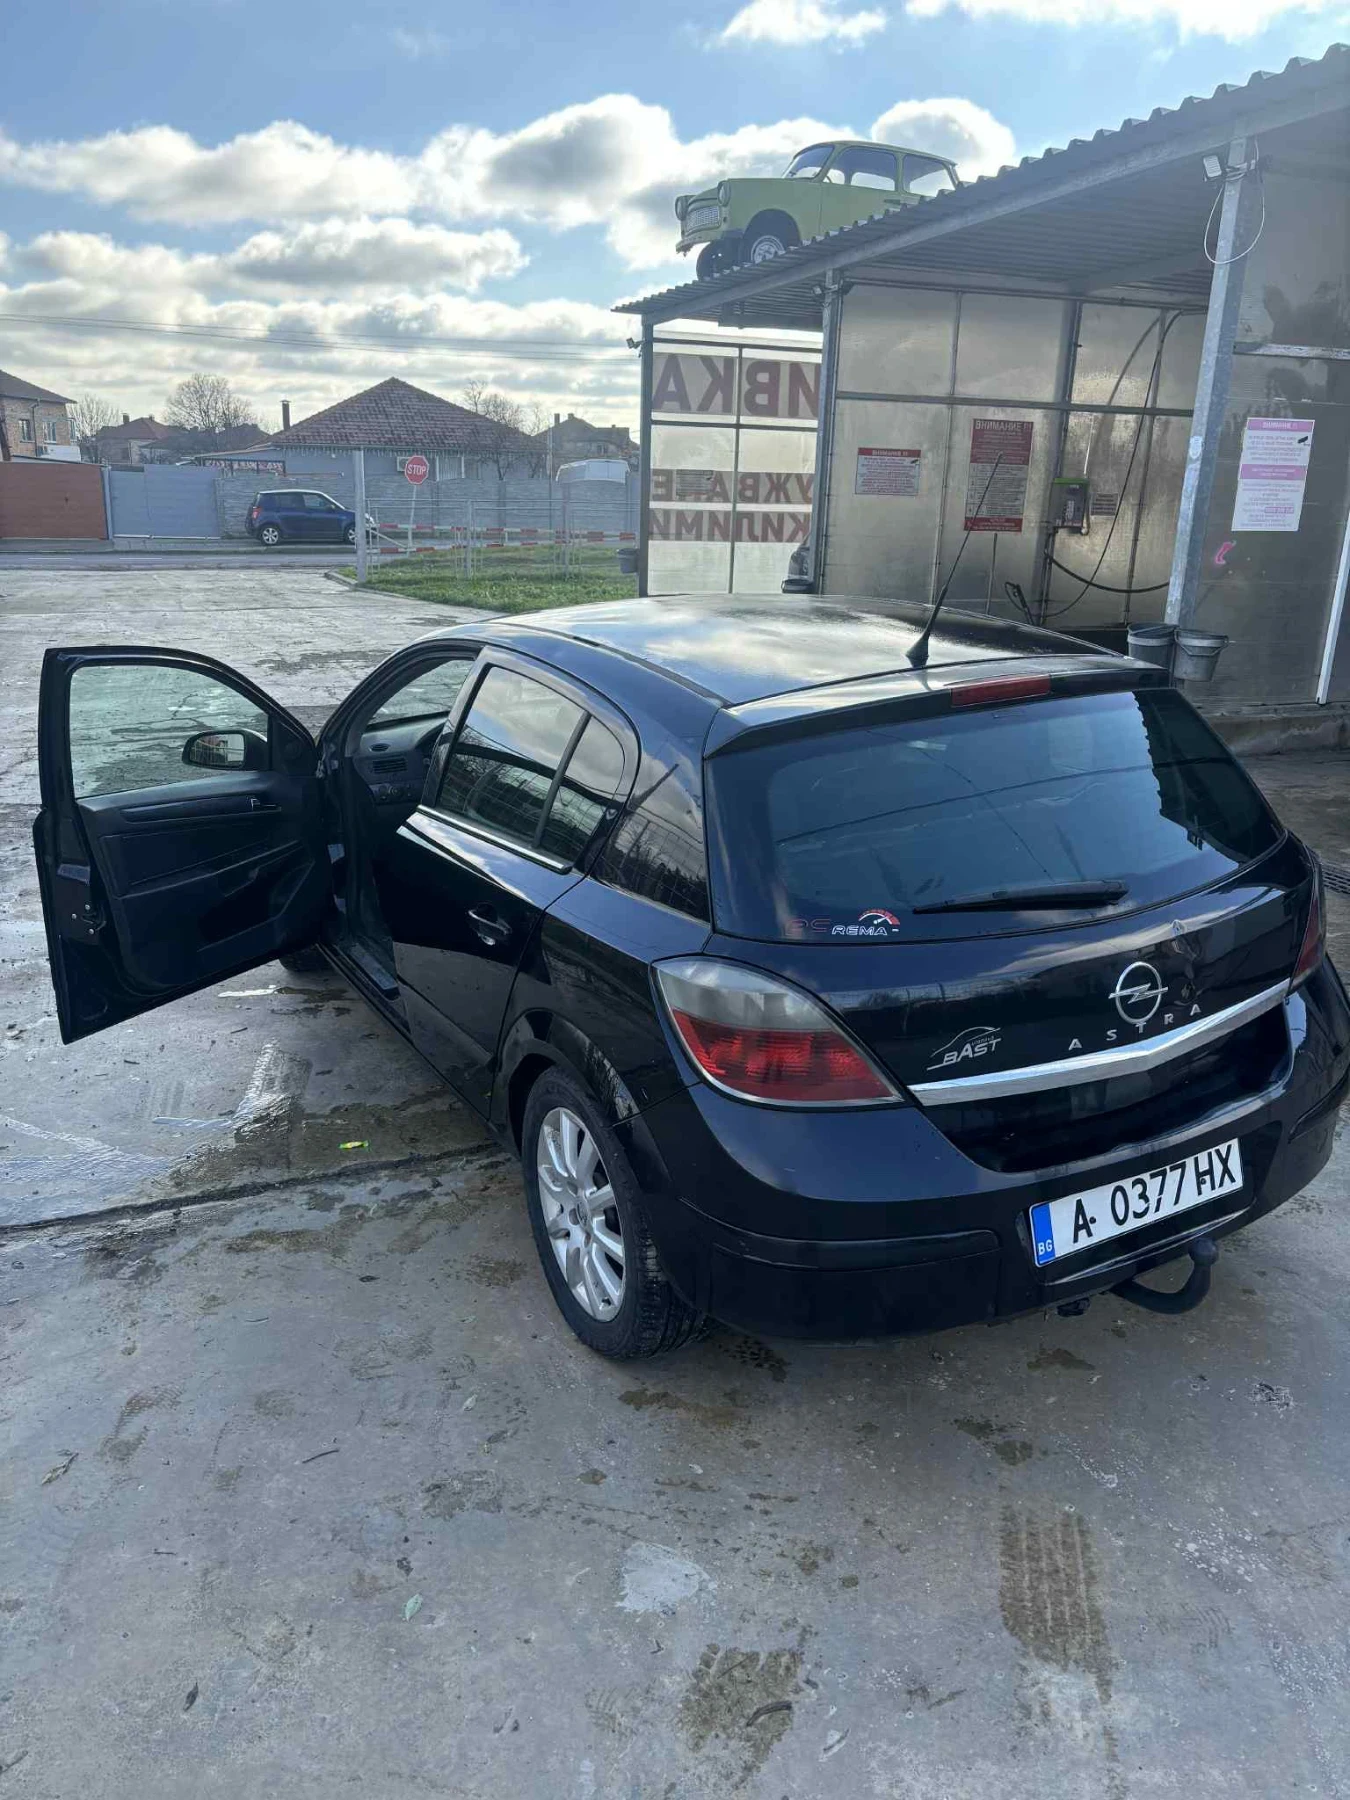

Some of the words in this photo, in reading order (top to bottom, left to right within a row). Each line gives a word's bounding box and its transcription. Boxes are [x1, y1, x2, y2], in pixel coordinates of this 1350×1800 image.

[975, 420, 1022, 431] ВНИМАНИЕ
[407, 464, 426, 475] STOP
[1068, 1003, 1202, 1051] ASTRA
[941, 1038, 1002, 1065] BAST
[1072, 1198, 1094, 1244] A
[1110, 1161, 1187, 1226] 0377
[1194, 1144, 1236, 1196] HX
[1037, 1239, 1053, 1256] BG
